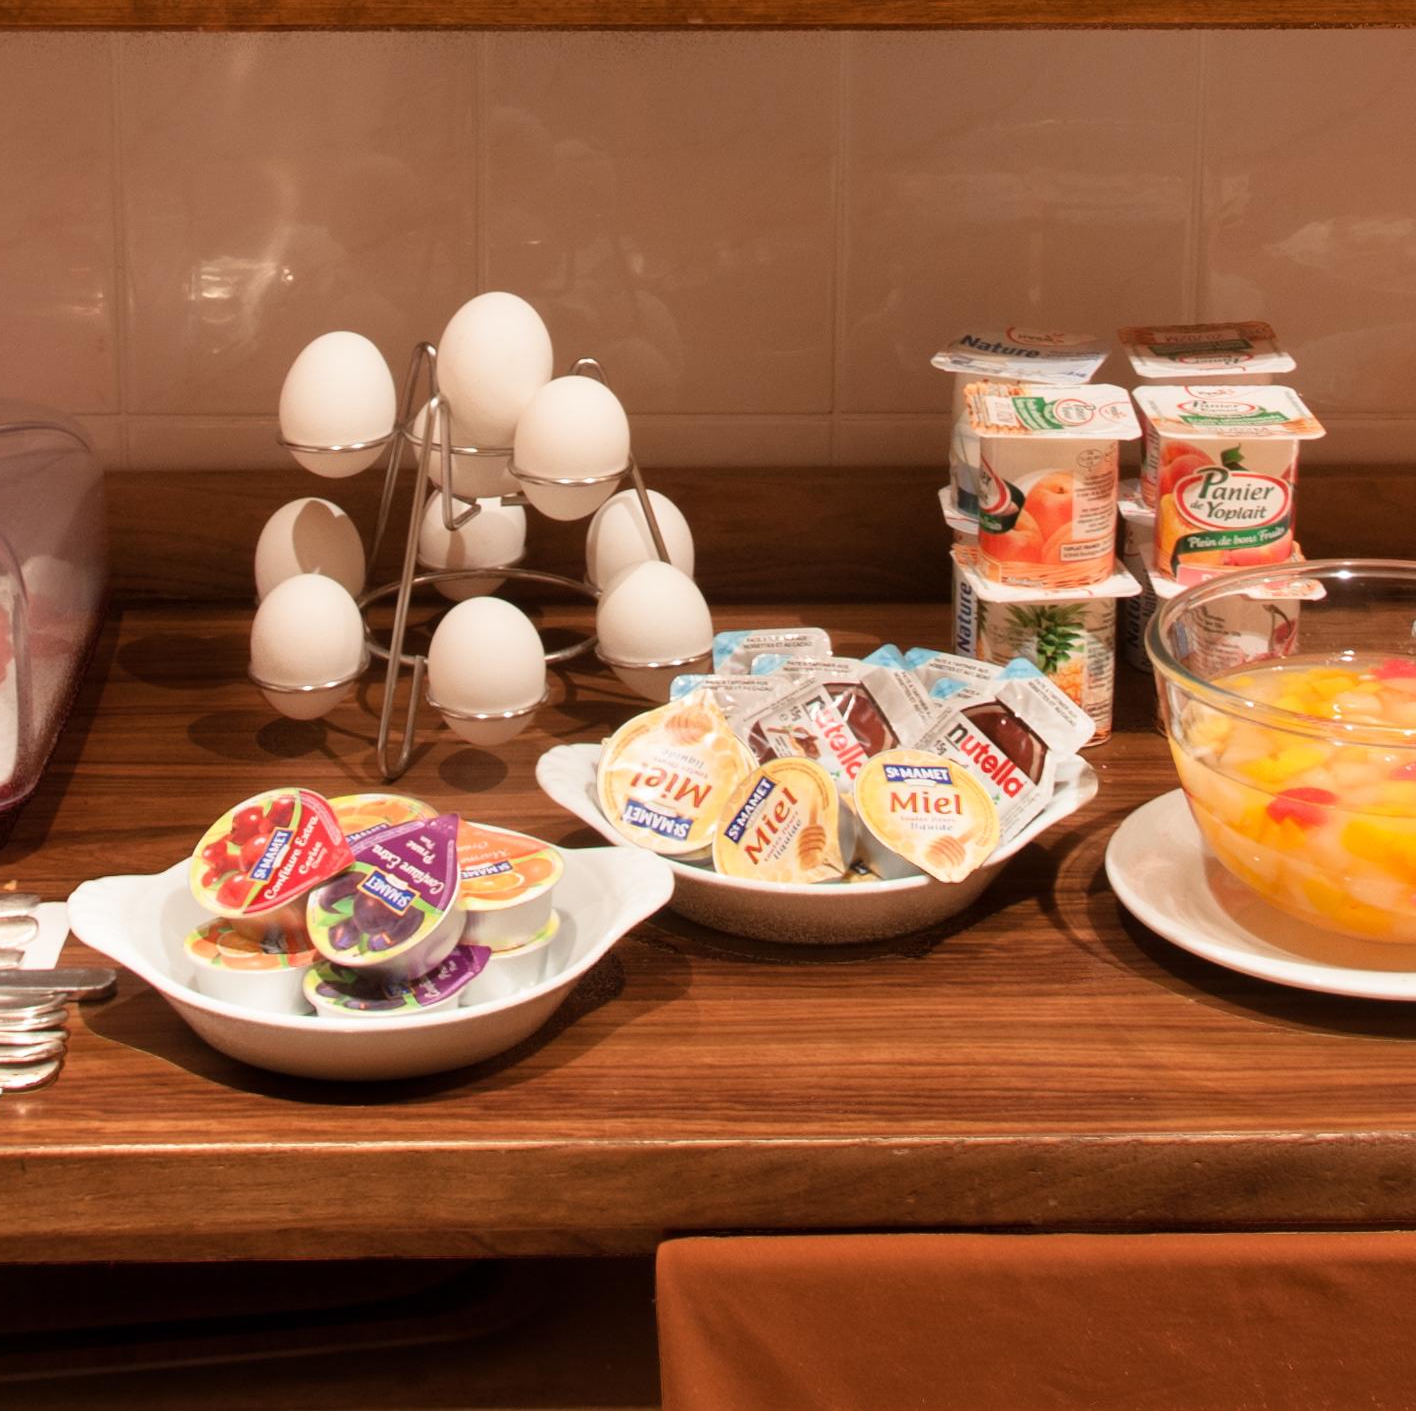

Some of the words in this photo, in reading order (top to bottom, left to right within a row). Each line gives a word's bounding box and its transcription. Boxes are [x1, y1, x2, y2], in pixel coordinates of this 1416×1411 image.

[960, 334, 1040, 359] Nature
[1197, 467, 1274, 501] Panier
[1190, 500, 1203, 510] de
[1206, 501, 1267, 521] Yoplait
[1187, 535, 1216, 549] Plein
[1218, 533, 1232, 546] de
[958, 581, 972, 653] Nature
[933, 738, 948, 755] 15g
[947, 722, 1025, 798] nutella
[630, 767, 713, 809] Miel
[889, 791, 963, 815] Miel
[744, 786, 798, 865] Miel
[264, 846, 302, 899] Confiture
[295, 815, 319, 846] Extra
[298, 841, 323, 874] Cerise
[372, 844, 402, 869] Extra
[406, 839, 436, 864] Prune
[399, 861, 444, 894] Confiture
